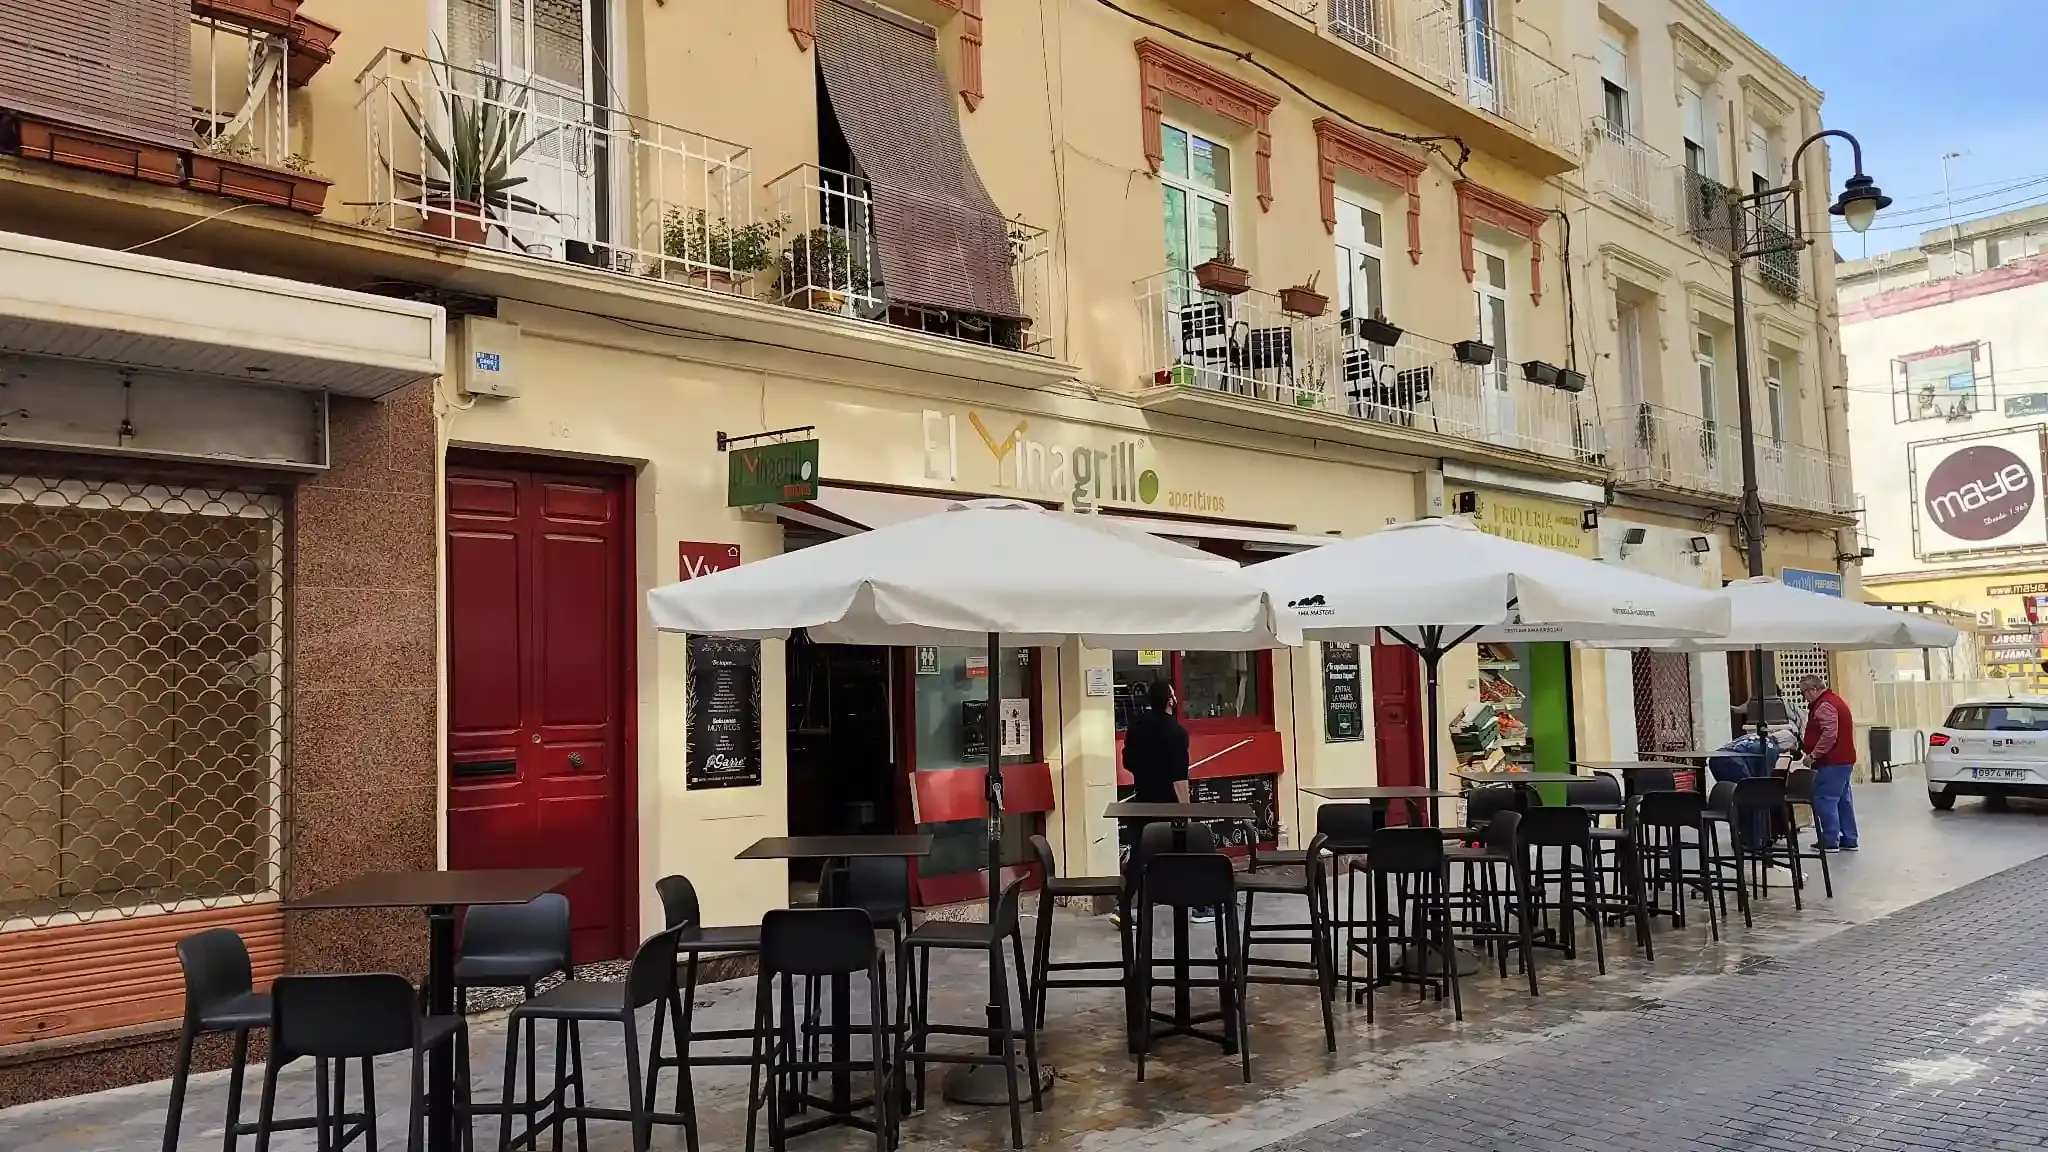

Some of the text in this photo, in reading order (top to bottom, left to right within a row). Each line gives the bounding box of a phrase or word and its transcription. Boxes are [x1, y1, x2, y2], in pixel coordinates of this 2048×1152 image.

[921, 408, 958, 483] El
[1168, 490, 1226, 513] aperitivos
[1930, 463, 2029, 523] maye
